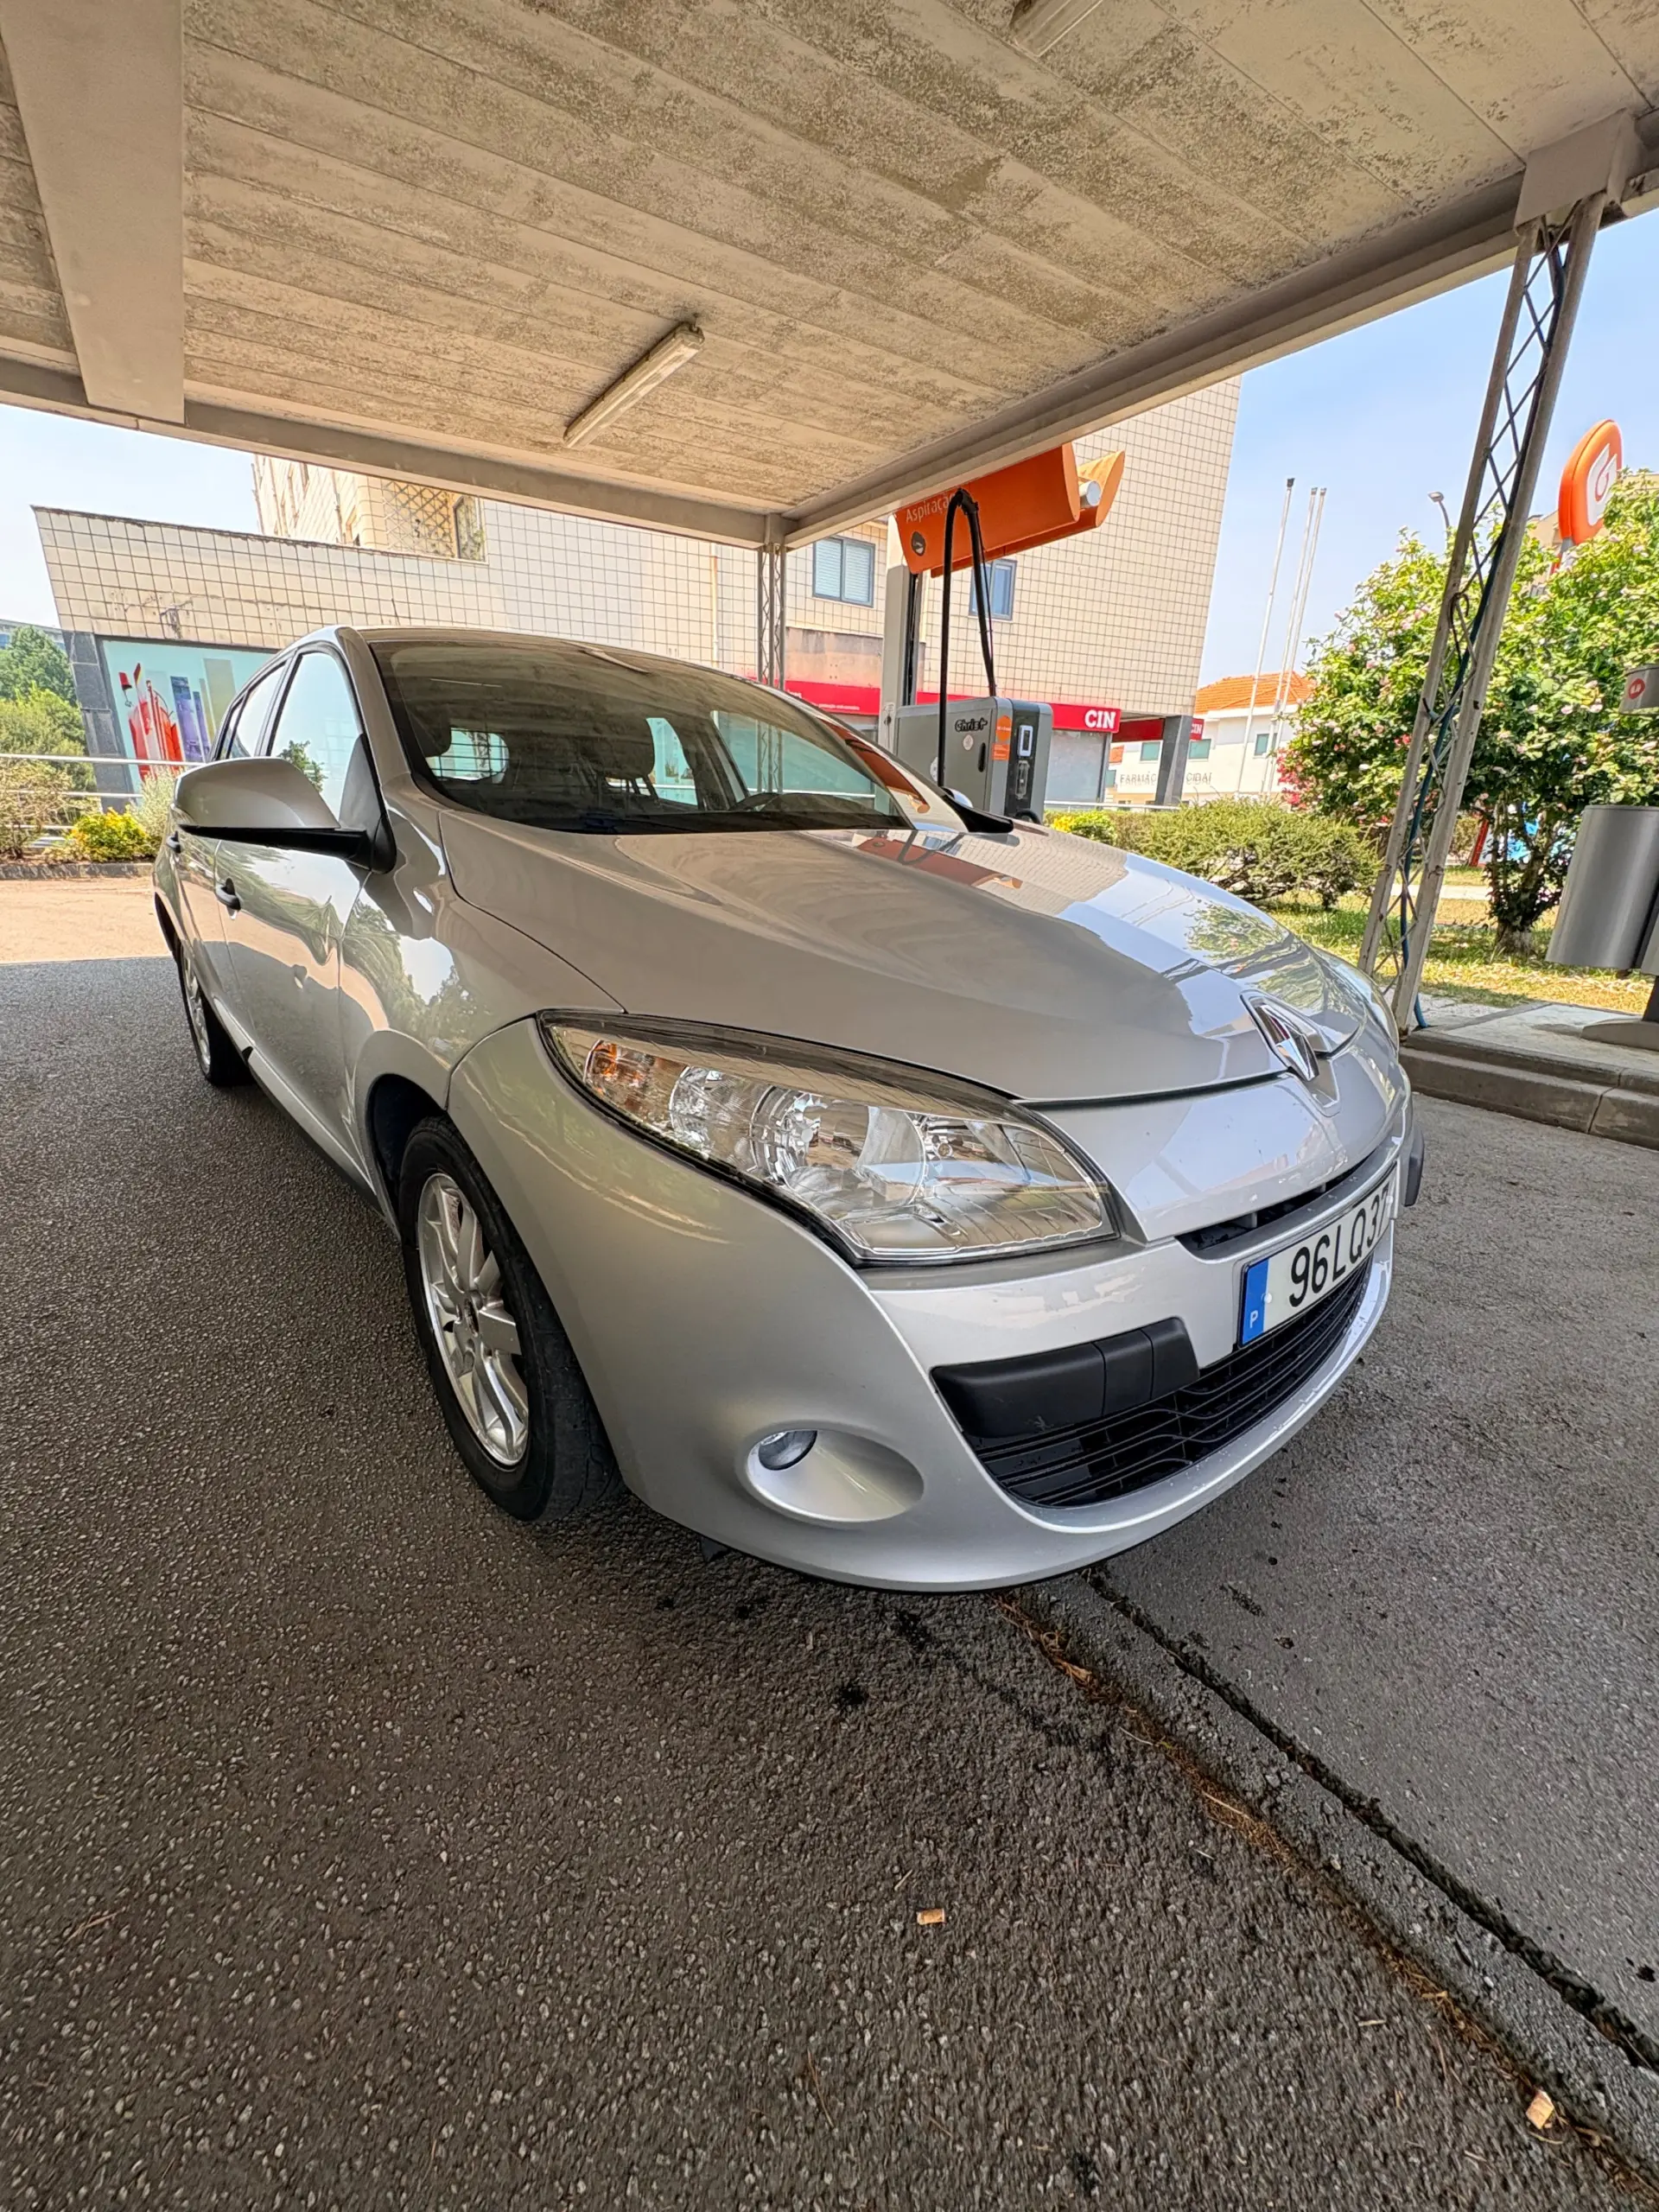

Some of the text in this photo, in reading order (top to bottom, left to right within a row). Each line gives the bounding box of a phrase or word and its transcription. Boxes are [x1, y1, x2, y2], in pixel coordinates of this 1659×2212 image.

[906, 492, 955, 524] Aspiraçã
[955, 717, 988, 733] Christ
[1084, 709, 1116, 729] CIN
[1120, 770, 1157, 785] FARMÁC
[1288, 1181, 1389, 1307] 96LQ37
[1249, 1310, 1259, 1328] P
